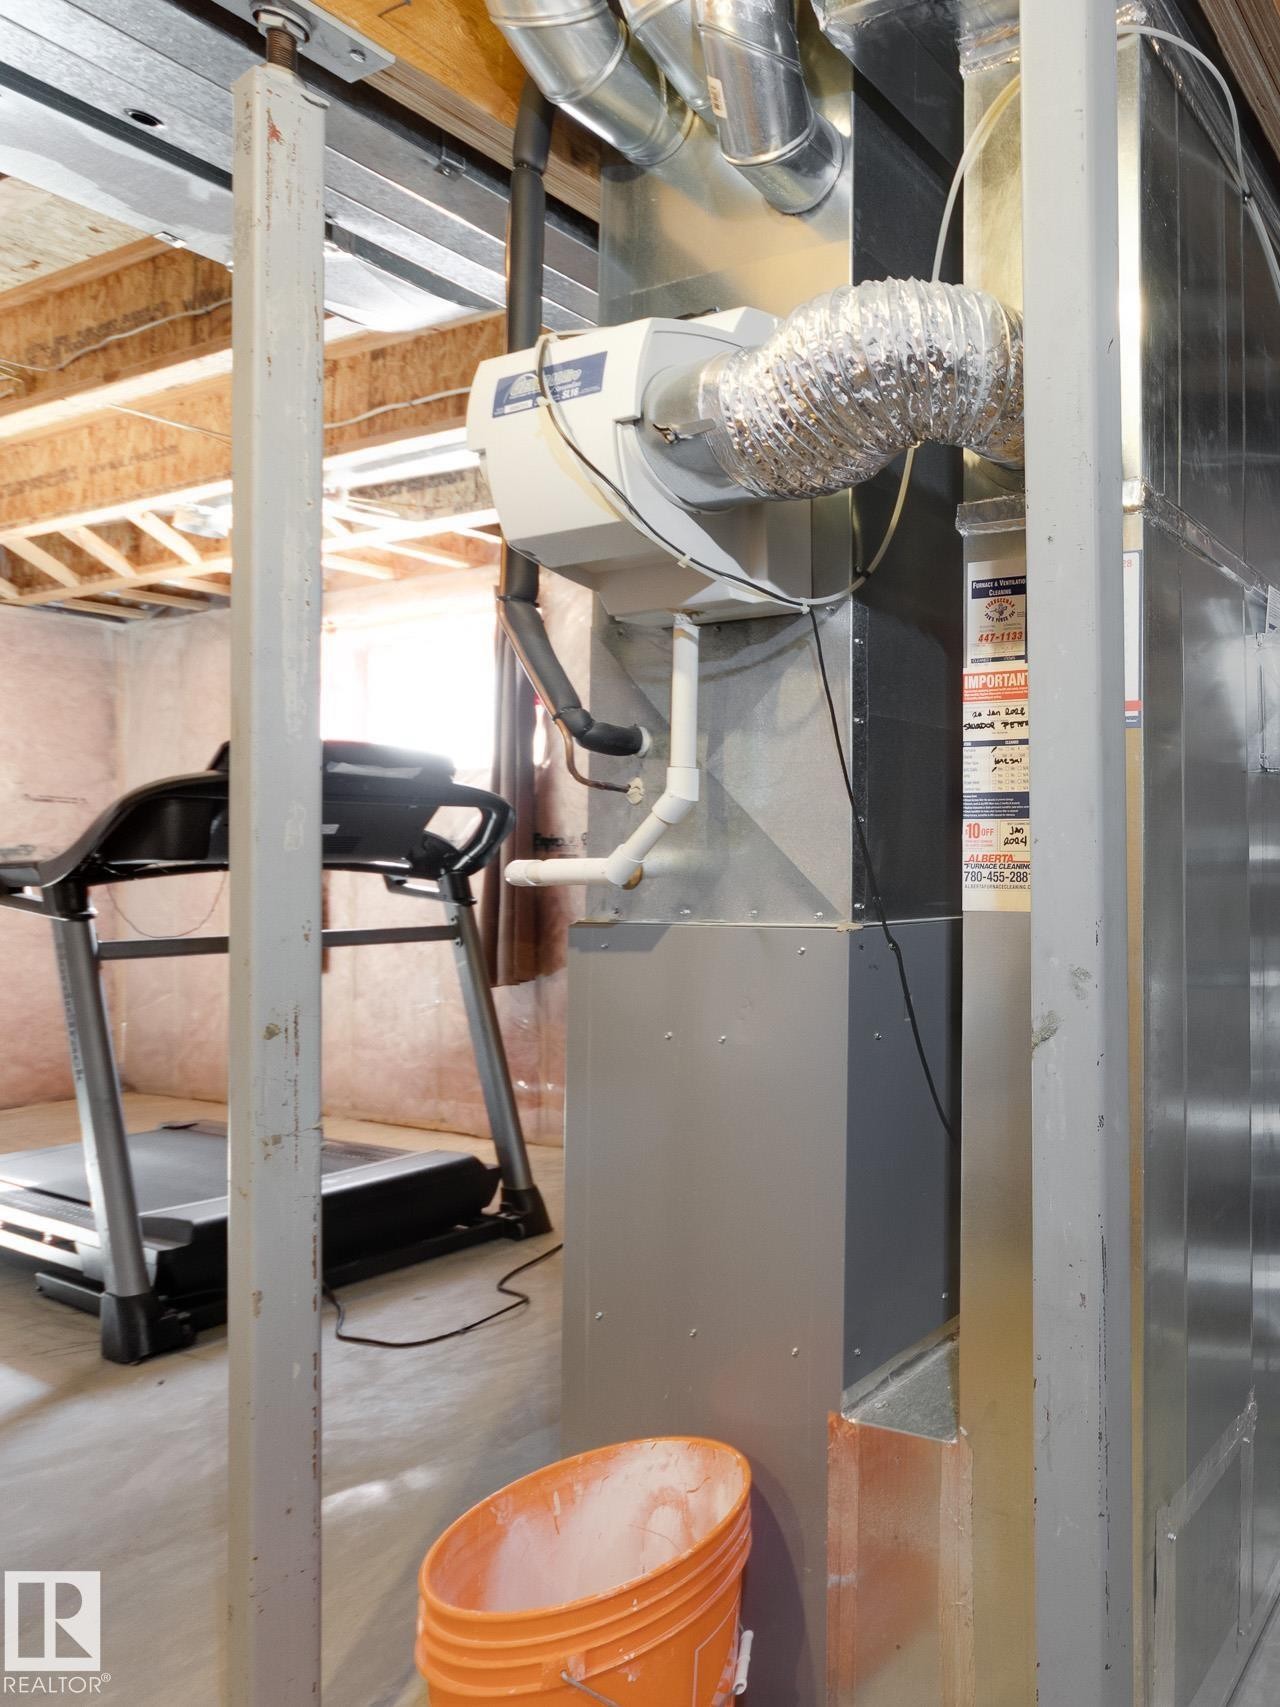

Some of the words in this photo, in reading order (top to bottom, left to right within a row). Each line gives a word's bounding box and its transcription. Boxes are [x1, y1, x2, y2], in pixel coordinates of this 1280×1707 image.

[973, 581, 993, 589] FURNACE
[1000, 579, 1026, 587] VENTILATIO
[989, 588, 1012, 596] CLEANING
[978, 631, 1023, 642] 447-1133
[981, 828, 994, 836] OFF
[1004, 835, 1027, 846] 2024
[967, 853, 1014, 863] ALBERTA
[964, 871, 1031, 882] 780-455-288
